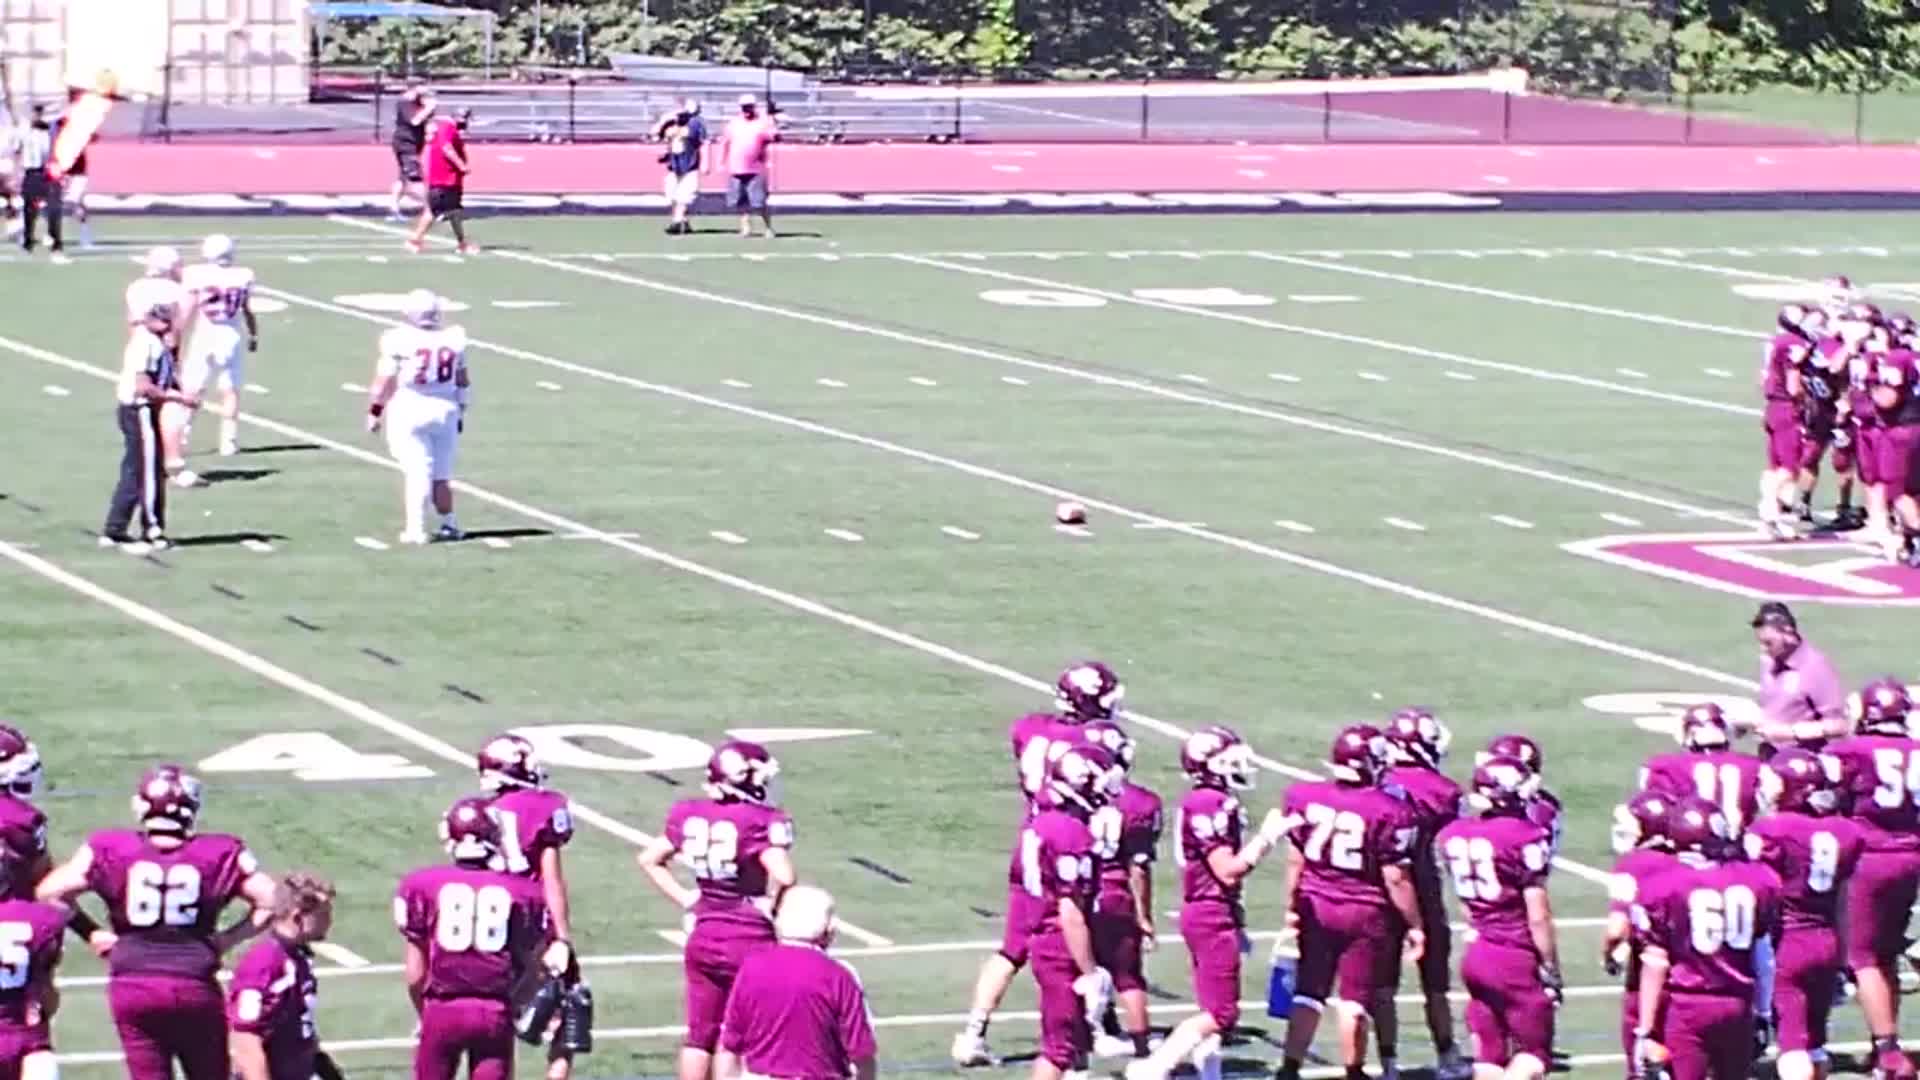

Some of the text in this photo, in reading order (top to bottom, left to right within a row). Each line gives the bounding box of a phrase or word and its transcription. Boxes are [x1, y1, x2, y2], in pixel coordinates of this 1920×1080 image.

[682, 816, 738, 880] 22
[1304, 803, 1365, 870] 72
[1445, 836, 1502, 900] 23
[126, 861, 202, 927] 62
[436, 882, 512, 953] 88
[1688, 885, 1756, 954] 60
